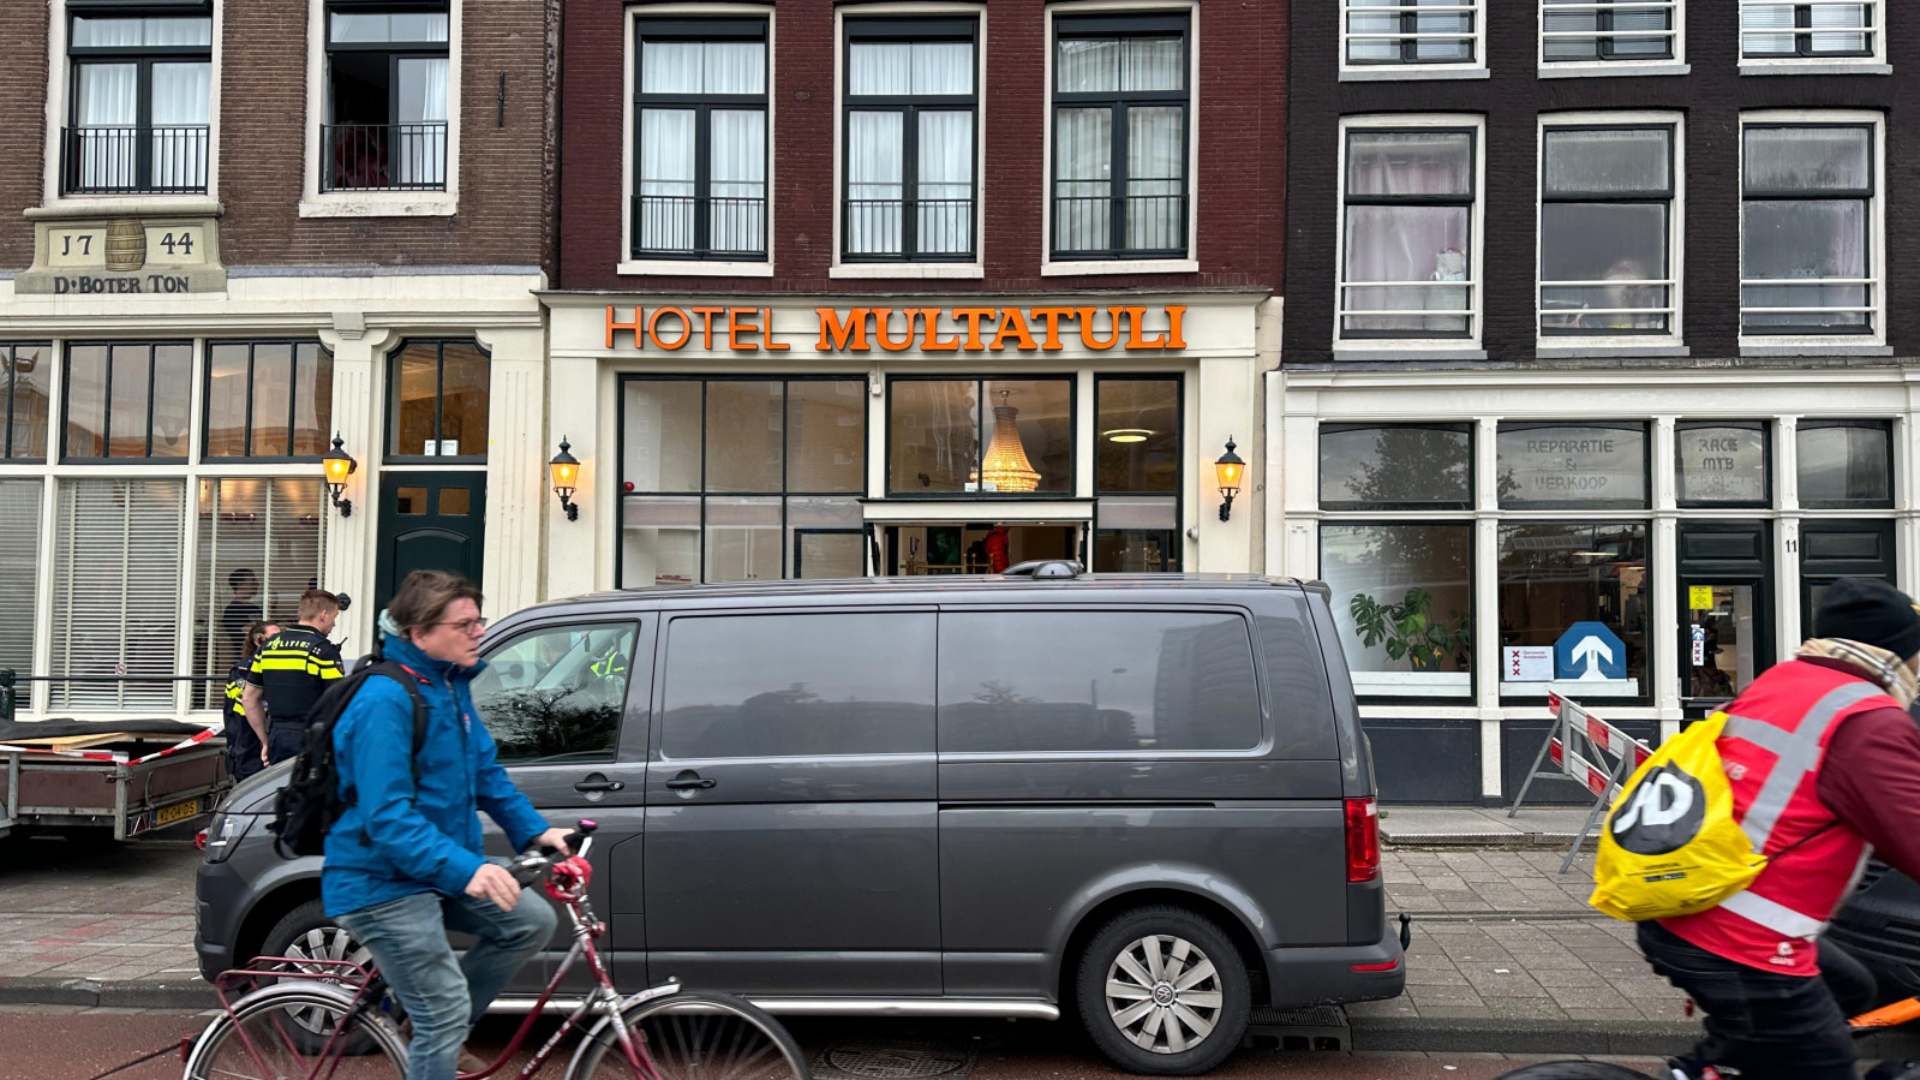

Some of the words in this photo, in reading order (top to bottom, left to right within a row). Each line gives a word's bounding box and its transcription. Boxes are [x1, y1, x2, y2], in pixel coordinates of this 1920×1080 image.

[160, 232, 194, 255] 44
[605, 305, 791, 351] HOTEL
[815, 305, 1187, 351] MULTATULI
[1526, 439, 1614, 453] REPARATIE
[1703, 457, 1735, 470] MTB
[1784, 538, 1797, 553] 11
